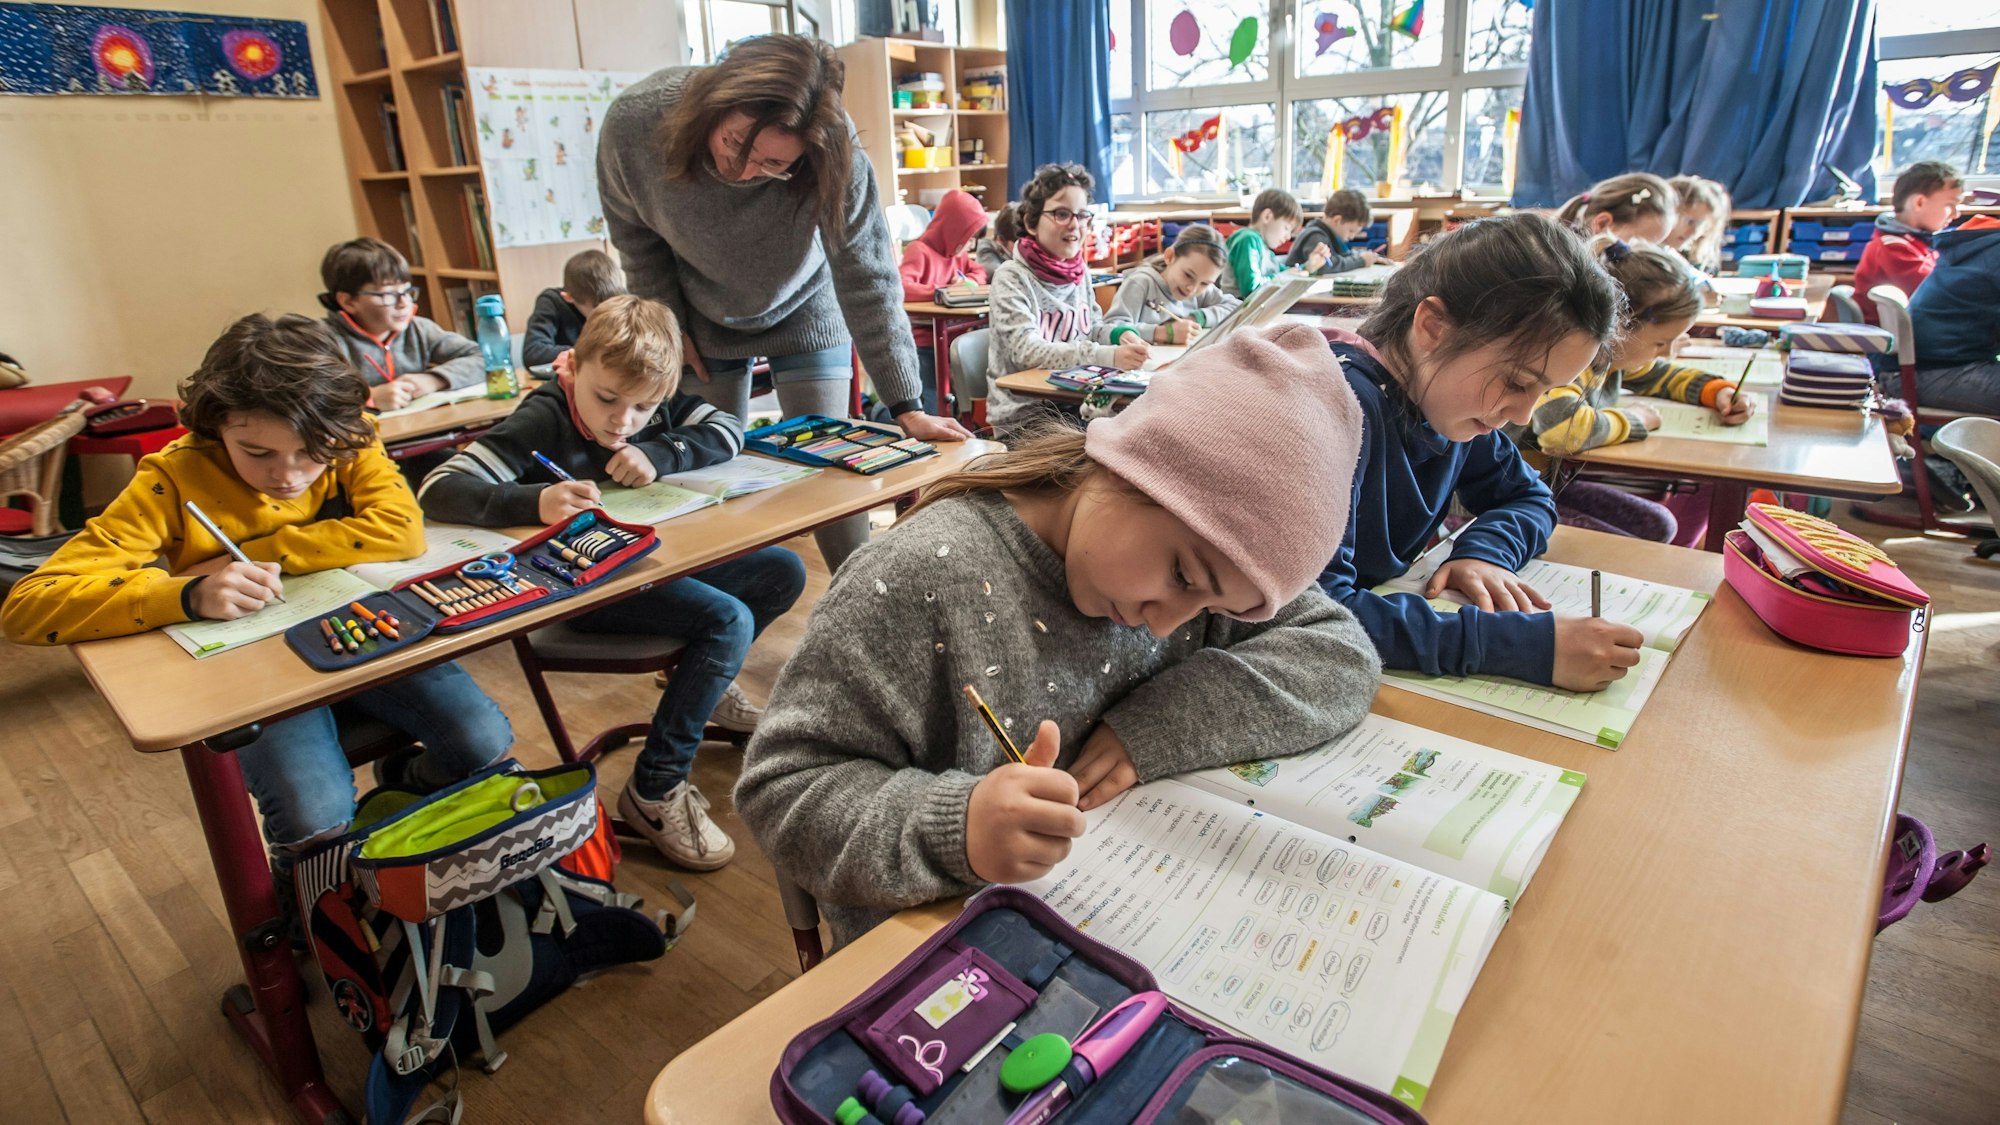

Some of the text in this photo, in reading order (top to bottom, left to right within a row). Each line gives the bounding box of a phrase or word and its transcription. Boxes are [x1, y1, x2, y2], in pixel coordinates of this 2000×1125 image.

[1148, 798, 1162, 813] stark
[1198, 814, 1218, 837] nützlich
[500, 836, 554, 871] ergobag
[1124, 844, 1144, 863] braver
[1254, 852, 1267, 870] Adjektive
[1304, 853, 1313, 863] jung
[1155, 854, 1171, 872] dicker
[1214, 856, 1228, 873] Markiere
[1241, 869, 1257, 888] geordnet
[1392, 879, 1401, 888] wild
[1260, 881, 1273, 900] schneller
[1279, 888, 1293, 907] schwerer
[1303, 896, 1314, 912] schnell
[1326, 904, 1336, 918] früher
[1073, 899, 1111, 932] langsamste
[1347, 910, 1359, 925] wilder
[1367, 915, 1382, 934] bequem
[1409, 915, 1420, 935] gehören
[1232, 926, 1246, 944] kleinsten
[1258, 934, 1267, 945] kühl
[1277, 935, 1293, 959] bequemer
[1298, 949, 1312, 971] wildesten
[1324, 956, 1336, 973] schwer
[1224, 978, 1237, 992] kleiner
[1344, 965, 1359, 988] jüngsten
[1274, 1000, 1282, 1011] klein
[1315, 1018, 1333, 1045] schnellsten
